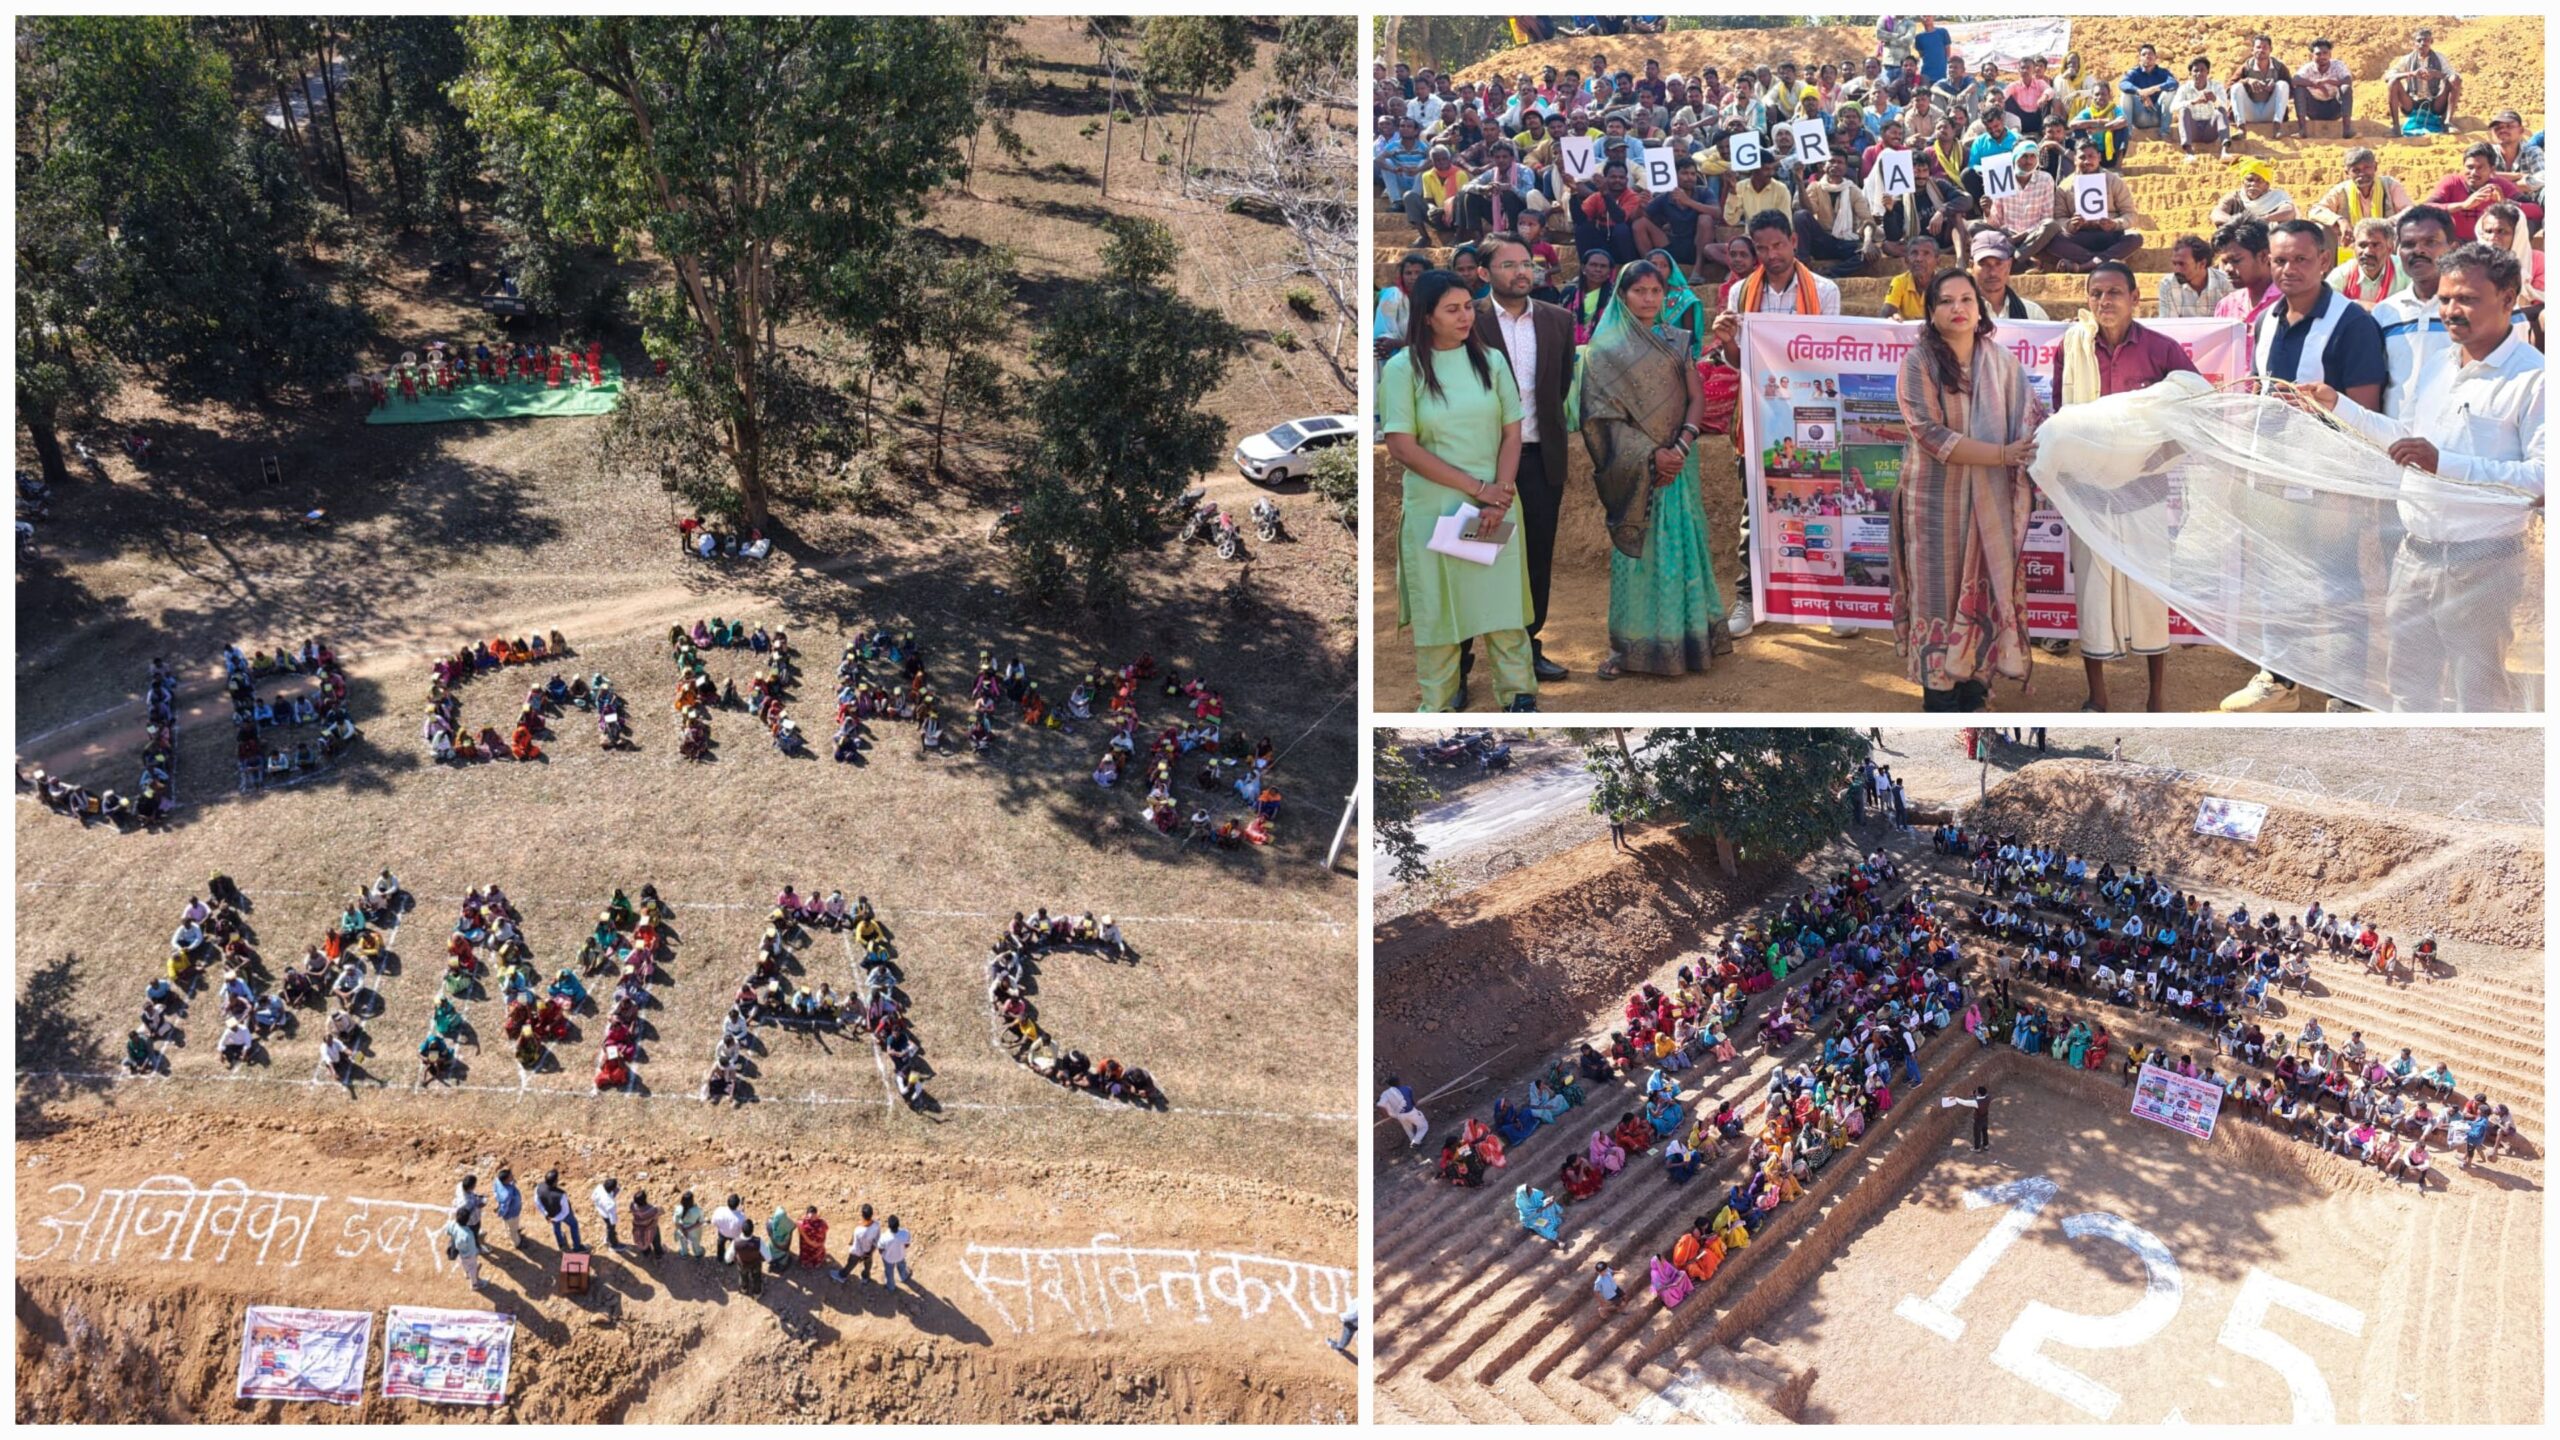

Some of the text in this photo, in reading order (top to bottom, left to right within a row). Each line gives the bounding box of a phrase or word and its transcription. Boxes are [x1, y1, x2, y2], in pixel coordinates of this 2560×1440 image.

[1566, 132, 2104, 215] V B G R A M G
[1787, 334, 1874, 362] (विकसित
[1876, 342, 1915, 362] भार
[1790, 597, 1830, 612] जनपद
[1835, 596, 1879, 613] पंचायत
[336, 1195, 461, 1279] डबर
[1893, 1174, 2366, 1424] 125
